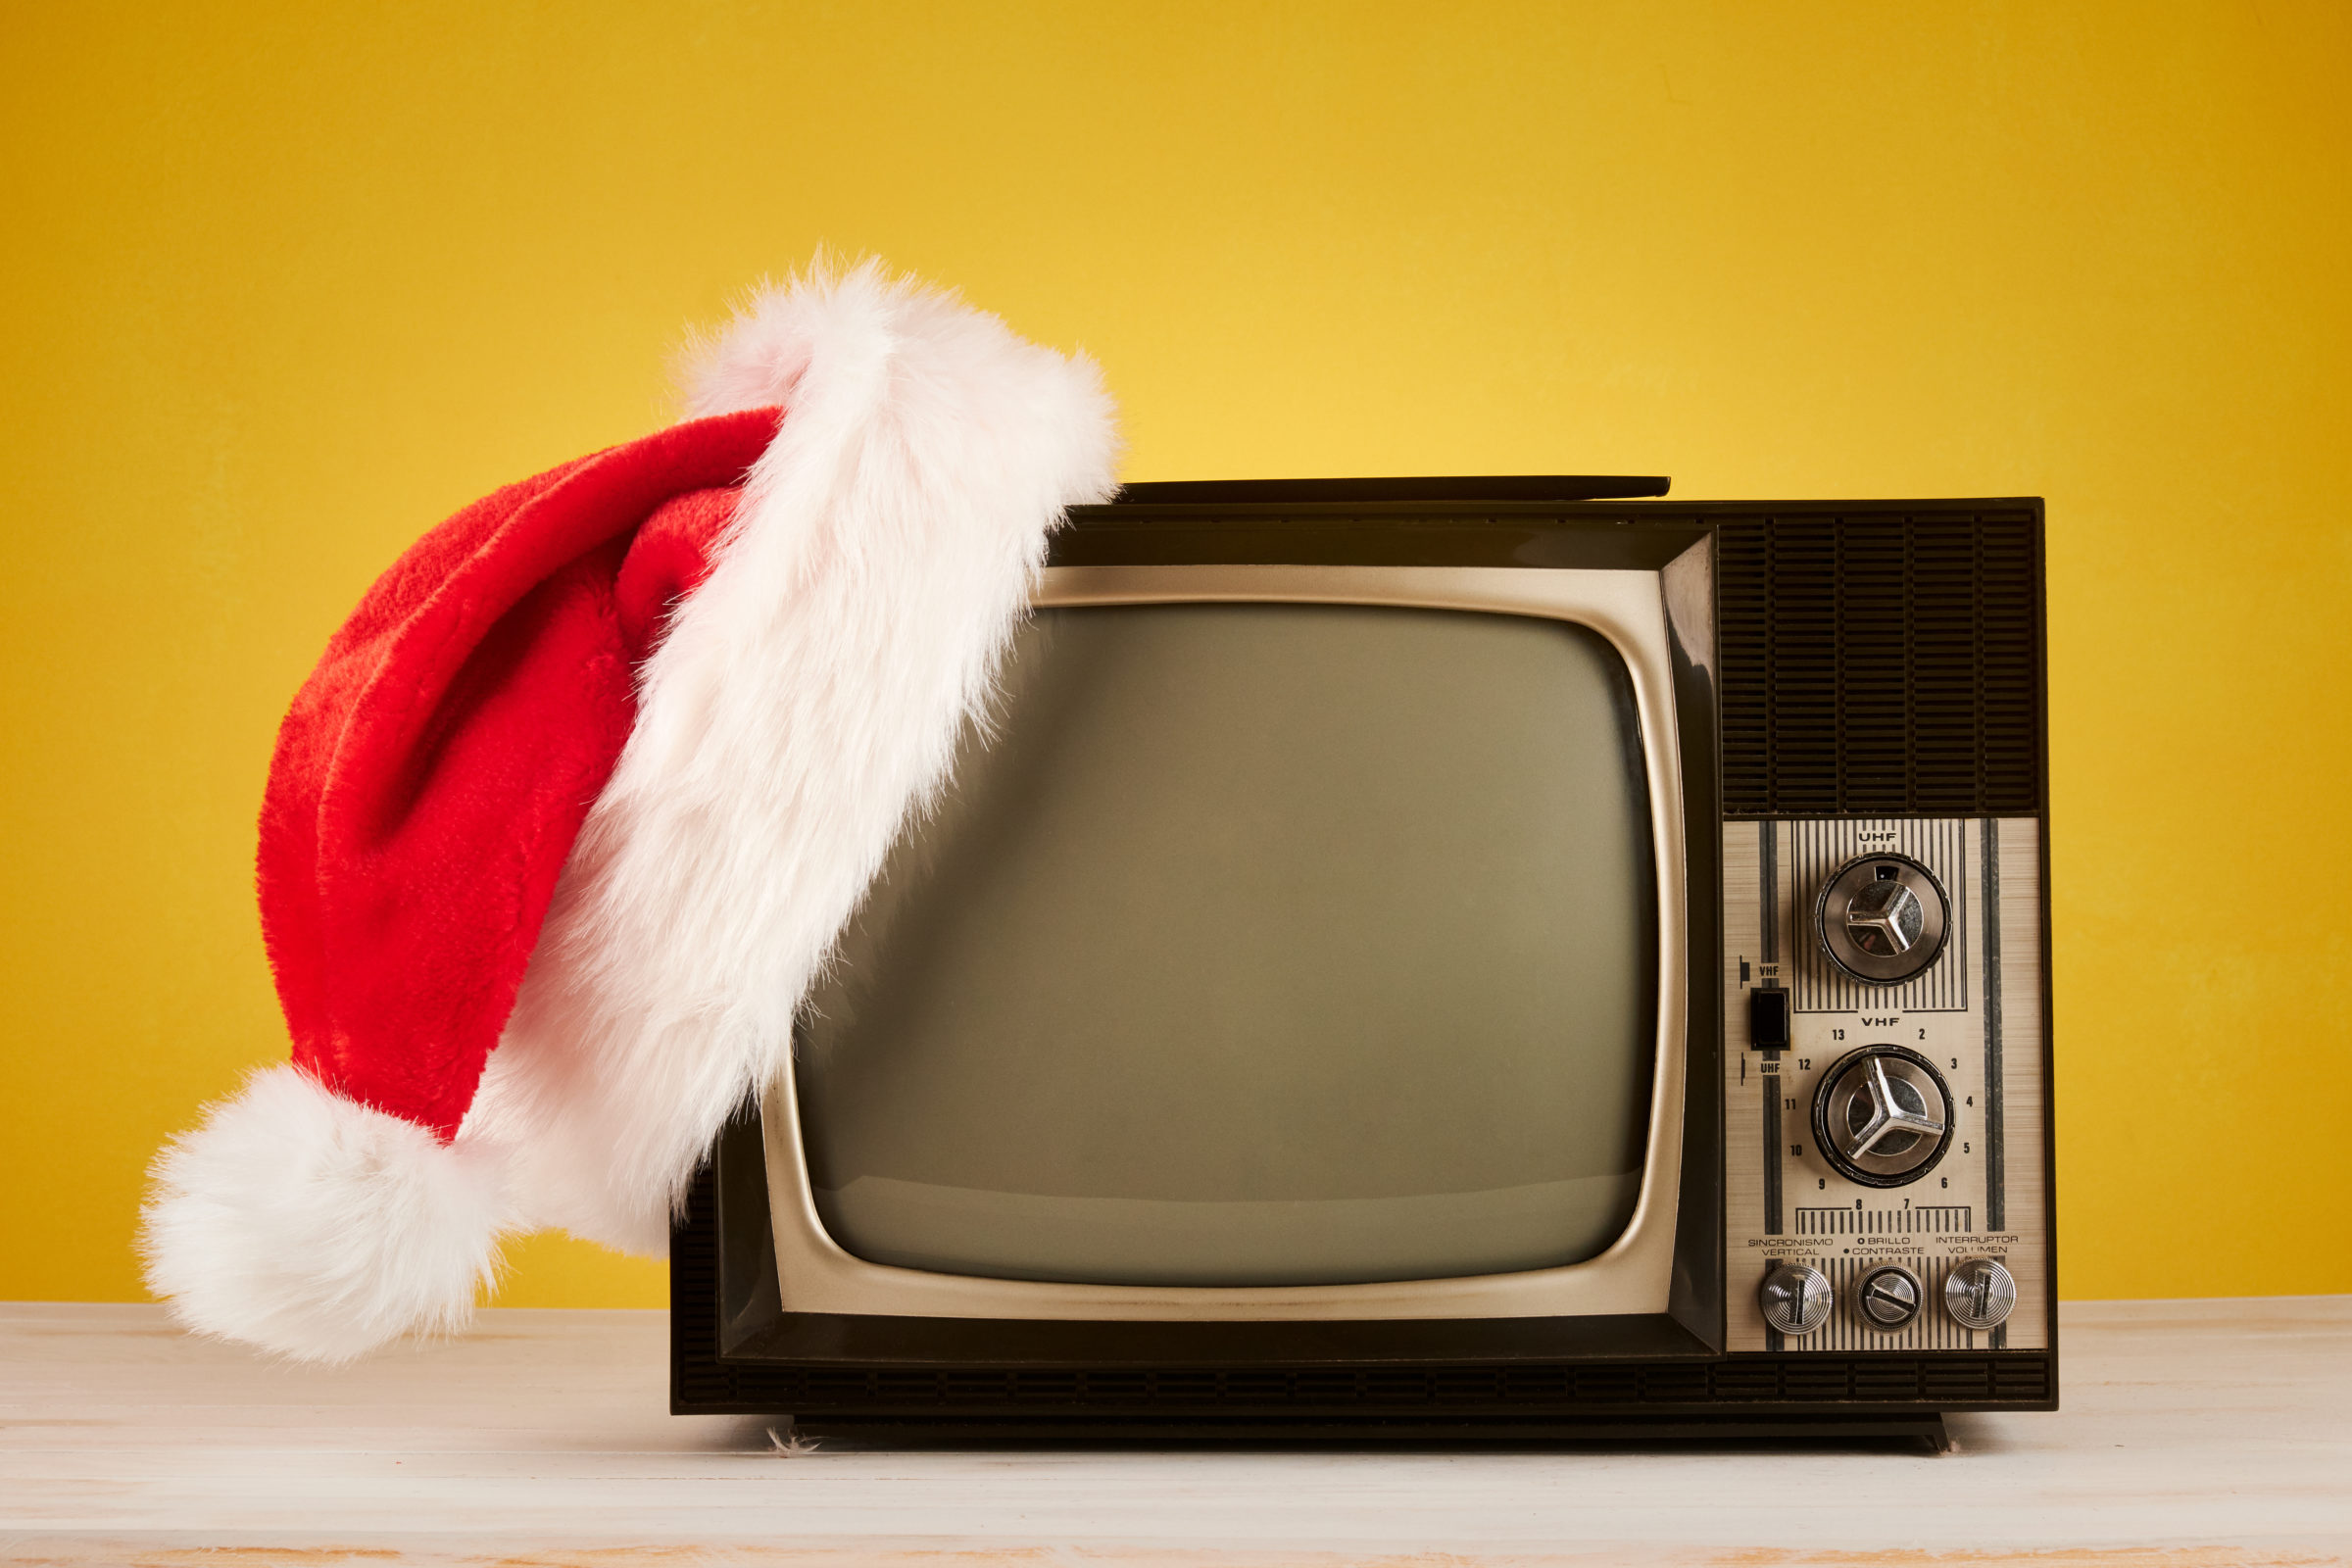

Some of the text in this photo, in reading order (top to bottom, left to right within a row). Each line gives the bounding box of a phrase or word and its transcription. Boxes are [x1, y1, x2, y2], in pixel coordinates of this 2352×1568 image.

[1858, 832, 1897, 843] UHF
[1759, 965, 1780, 977] VHF
[1861, 1017, 1900, 1027] VHF
[1832, 1029, 1845, 1041] 13
[1919, 1028, 1926, 1040] 2
[1760, 1062, 1781, 1074] UHF
[1798, 1058, 1811, 1070] 12
[1950, 1058, 1958, 1070] 3
[1785, 1099, 1796, 1110] 11
[1966, 1096, 1974, 1107] 4
[1790, 1145, 1802, 1156] 10
[1963, 1142, 1970, 1153] 5
[1818, 1178, 1826, 1190] 9
[1940, 1177, 1948, 1189] 6
[1855, 1199, 1862, 1210] 8
[1903, 1198, 1910, 1209] 7
[1747, 1238, 1834, 1248] SINCRONISMO
[1936, 1235, 2019, 1244] INTERRUPTOR
[1852, 1247, 1925, 1255] CONTRASTE
